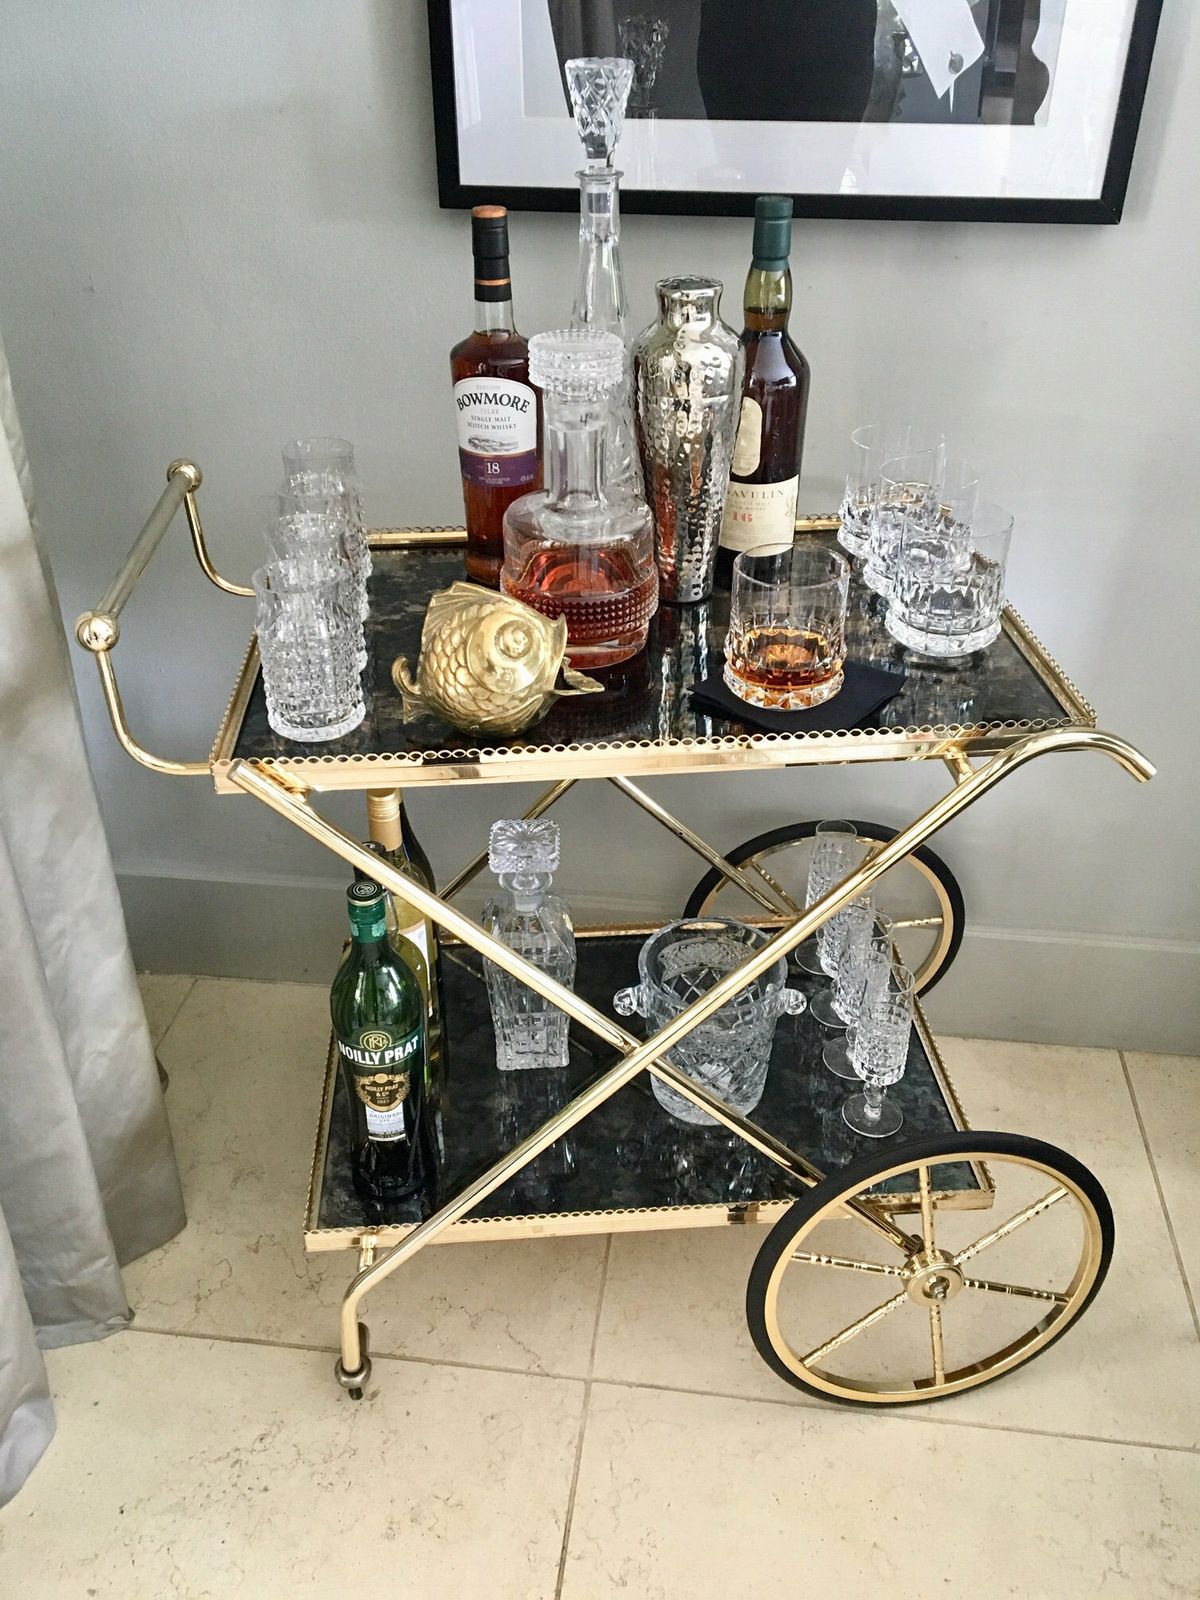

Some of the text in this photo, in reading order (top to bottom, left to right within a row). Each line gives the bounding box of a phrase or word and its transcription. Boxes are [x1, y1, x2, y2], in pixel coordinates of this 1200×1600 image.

[456, 393, 530, 414] BOWMORE
[467, 420, 490, 430] SCOTCH
[486, 461, 501, 474] 18
[732, 511, 753, 522] 16
[337, 1035, 419, 1065] NOILLY PRAT
